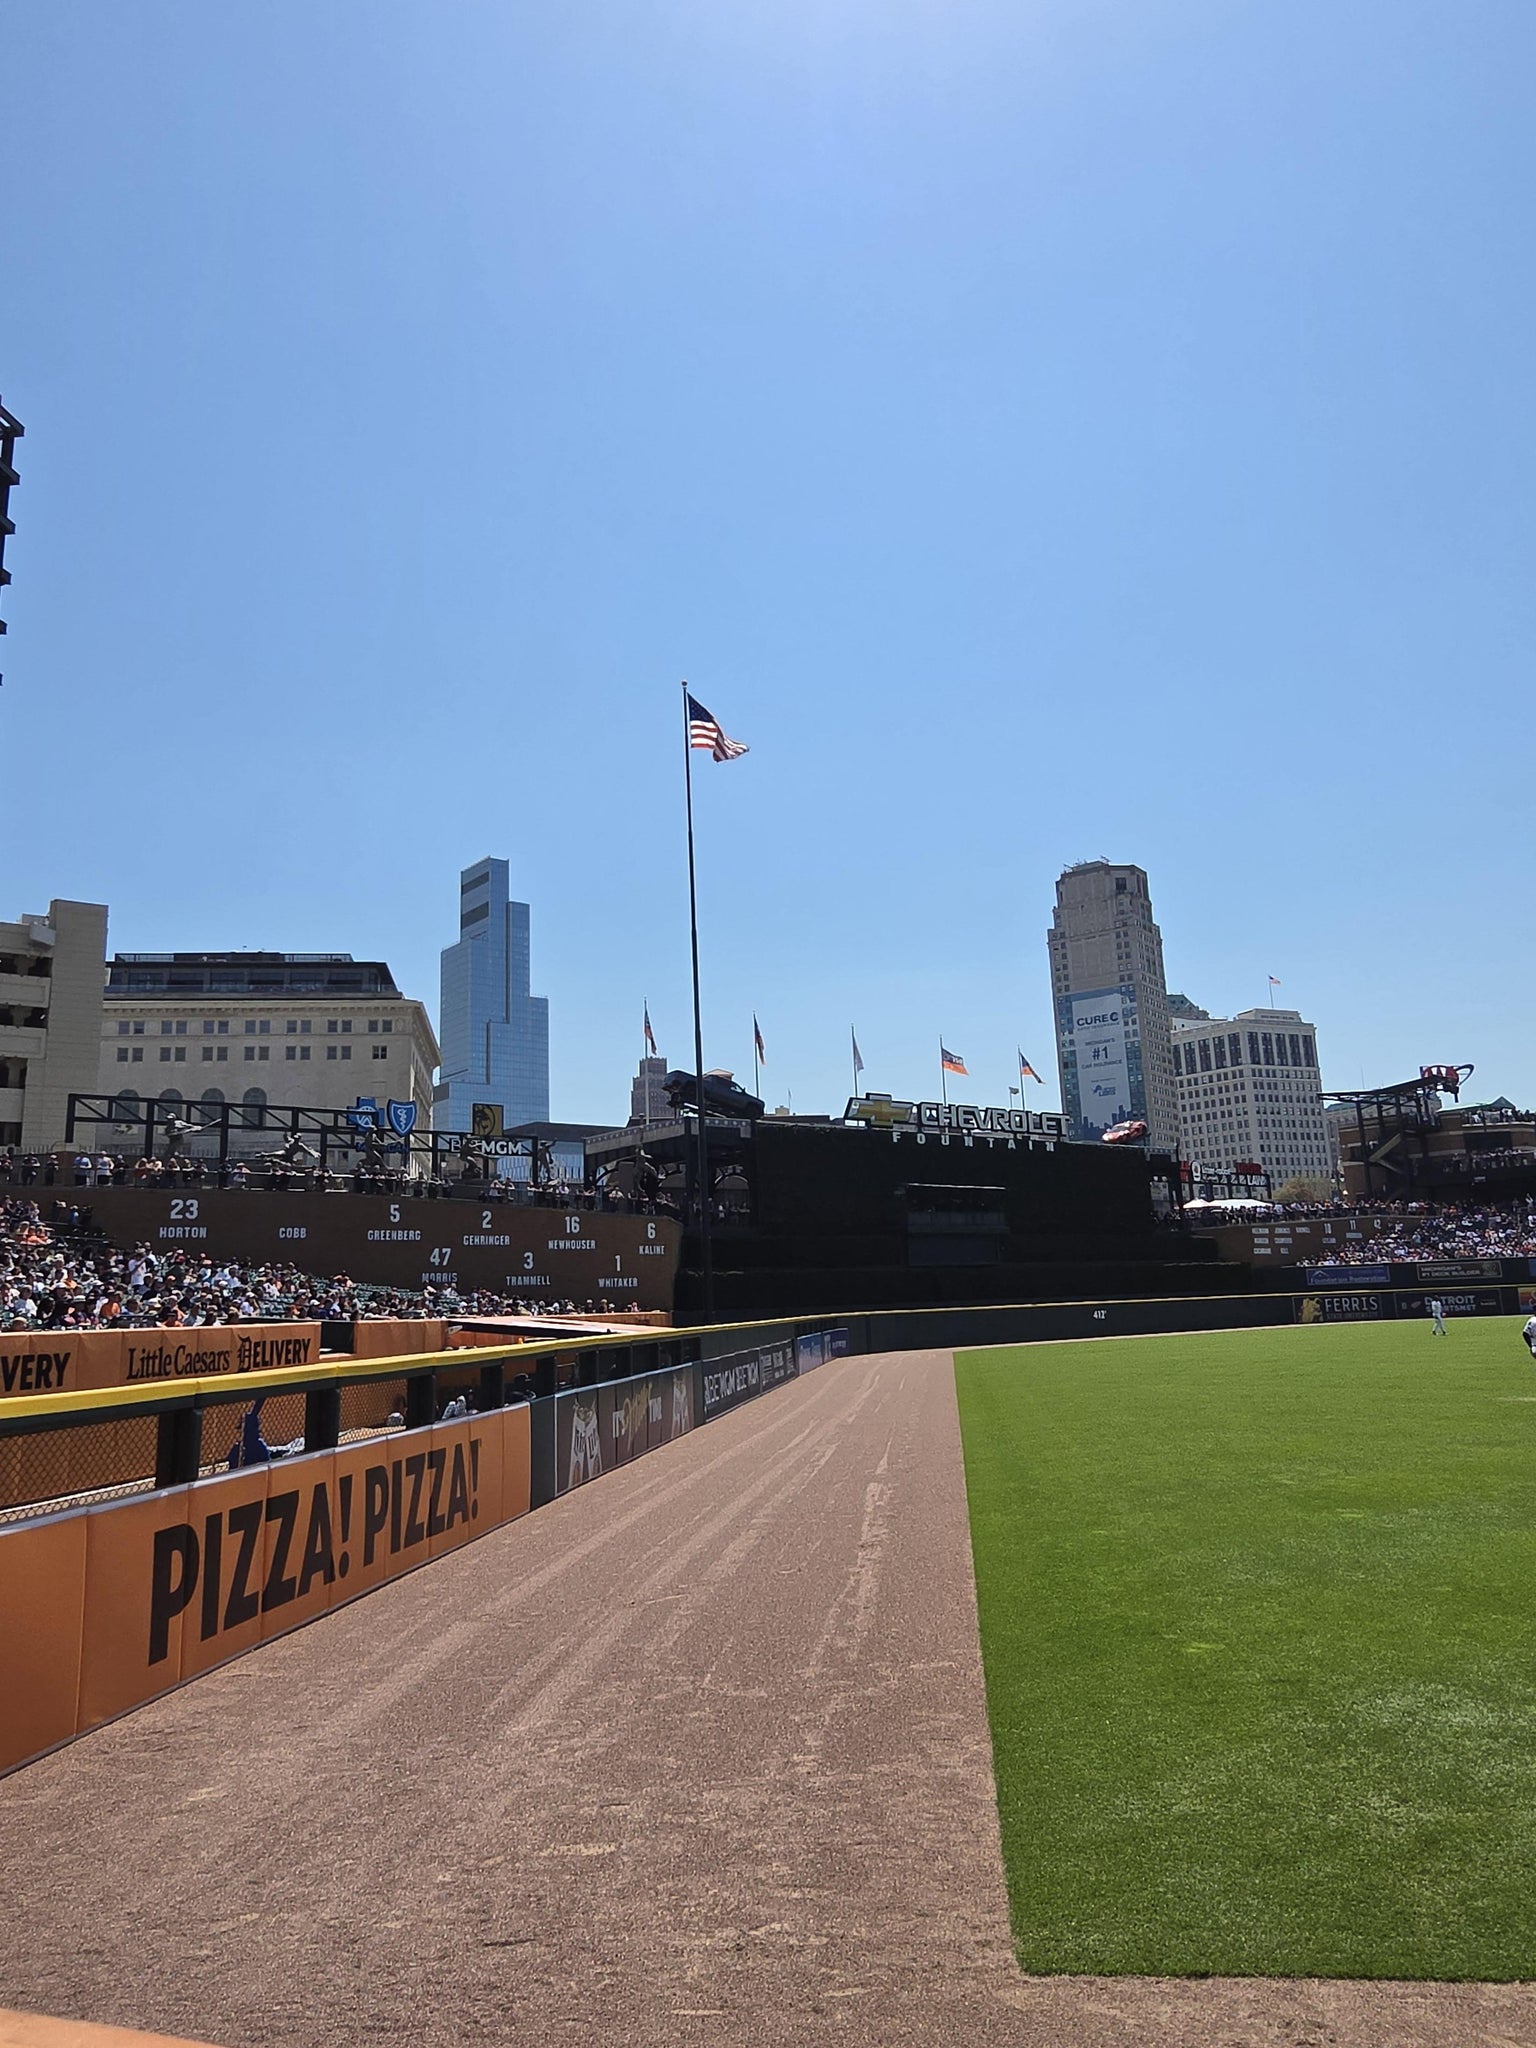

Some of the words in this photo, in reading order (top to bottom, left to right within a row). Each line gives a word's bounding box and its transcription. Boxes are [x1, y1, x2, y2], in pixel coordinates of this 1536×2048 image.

[1076, 1014, 1109, 1026] CURE
[1092, 1046, 1109, 1060] #1
[920, 1102, 1071, 1136] CHEVROLET
[892, 1131, 1055, 1152] FOUNTAIN
[169, 1198, 200, 1220] 23
[389, 1204, 401, 1223] 5
[481, 1210, 493, 1229] 2
[564, 1216, 581, 1234] 16
[159, 1226, 208, 1239] HORTON
[278, 1227, 308, 1239] COBB
[367, 1229, 422, 1241] GREENBERG
[647, 1222, 656, 1240] 6
[463, 1234, 511, 1246] GEHRINGER
[548, 1239, 597, 1250] NEWHOUSER
[429, 1247, 452, 1267] 47
[638, 1244, 666, 1256] KALINE
[523, 1251, 534, 1270] 3
[614, 1254, 622, 1272] 1
[421, 1272, 459, 1283] MORRIS
[505, 1275, 551, 1286] TRAMMELL
[598, 1277, 639, 1288] WHITAKER
[1324, 1296, 1378, 1312] FERRIS
[1424, 1295, 1476, 1306] DTROIT
[126, 1345, 173, 1380] Little
[174, 1344, 230, 1378] Caesars
[237, 1334, 312, 1374] DELIVERY
[148, 1474, 354, 1667] PIZZA!
[363, 1438, 483, 1568] PIZZA!
